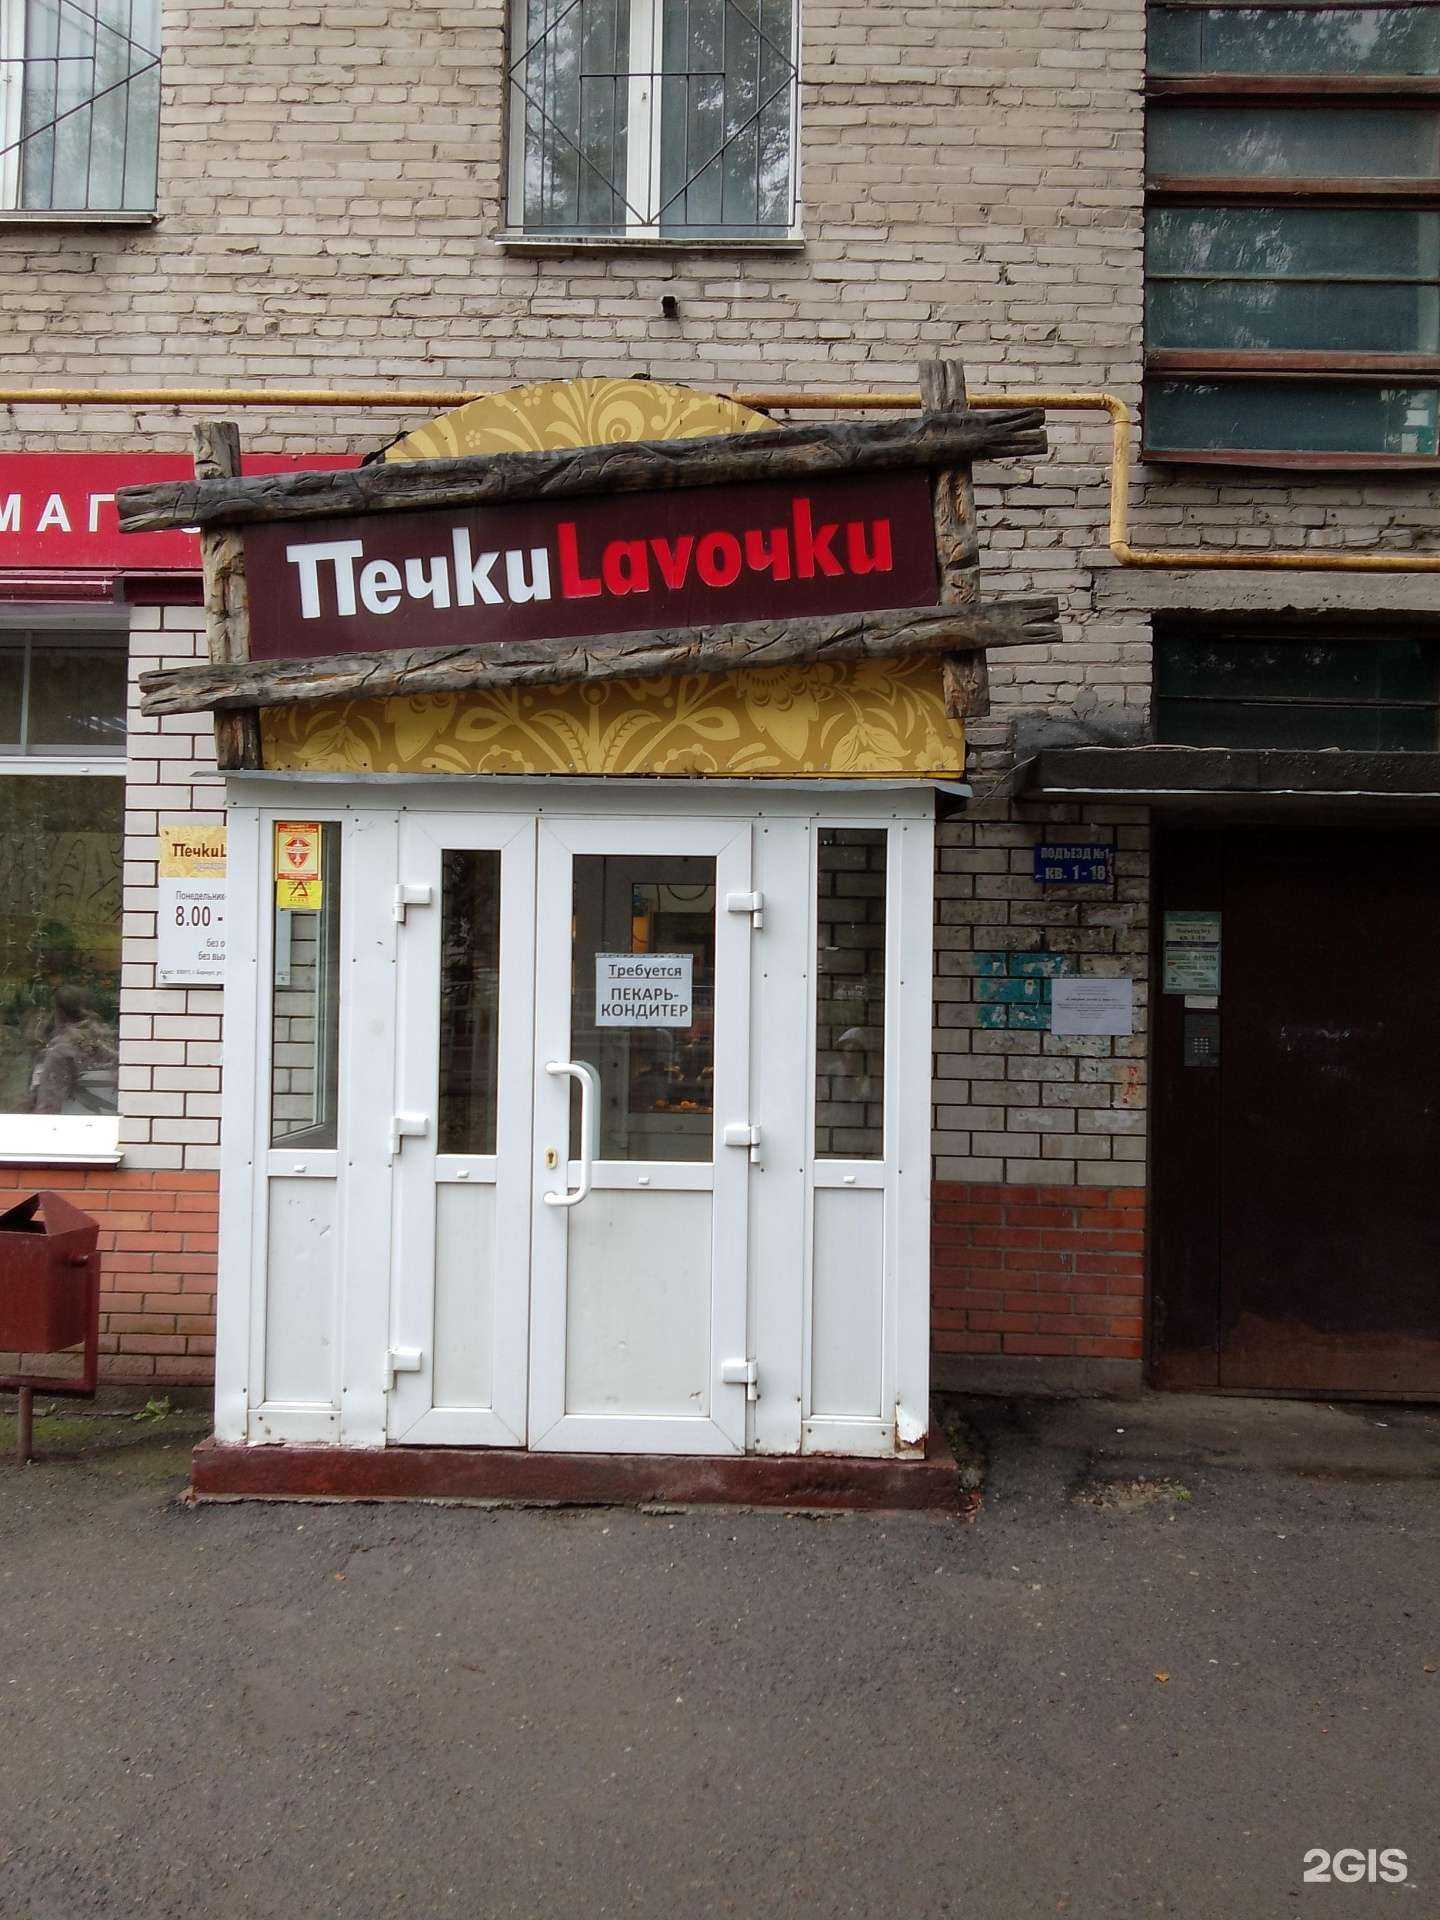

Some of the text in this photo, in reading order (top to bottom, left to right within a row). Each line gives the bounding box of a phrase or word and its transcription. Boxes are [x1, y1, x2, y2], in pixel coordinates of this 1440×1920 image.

[1040, 847, 1091, 860] ПОДЪЕЗД
[175, 905, 211, 927] 8.00
[608, 964, 682, 978] Требуется
[611, 987, 679, 1001] ПЕКАРЬ-
[601, 1003, 689, 1019] КОНДИТЕР
